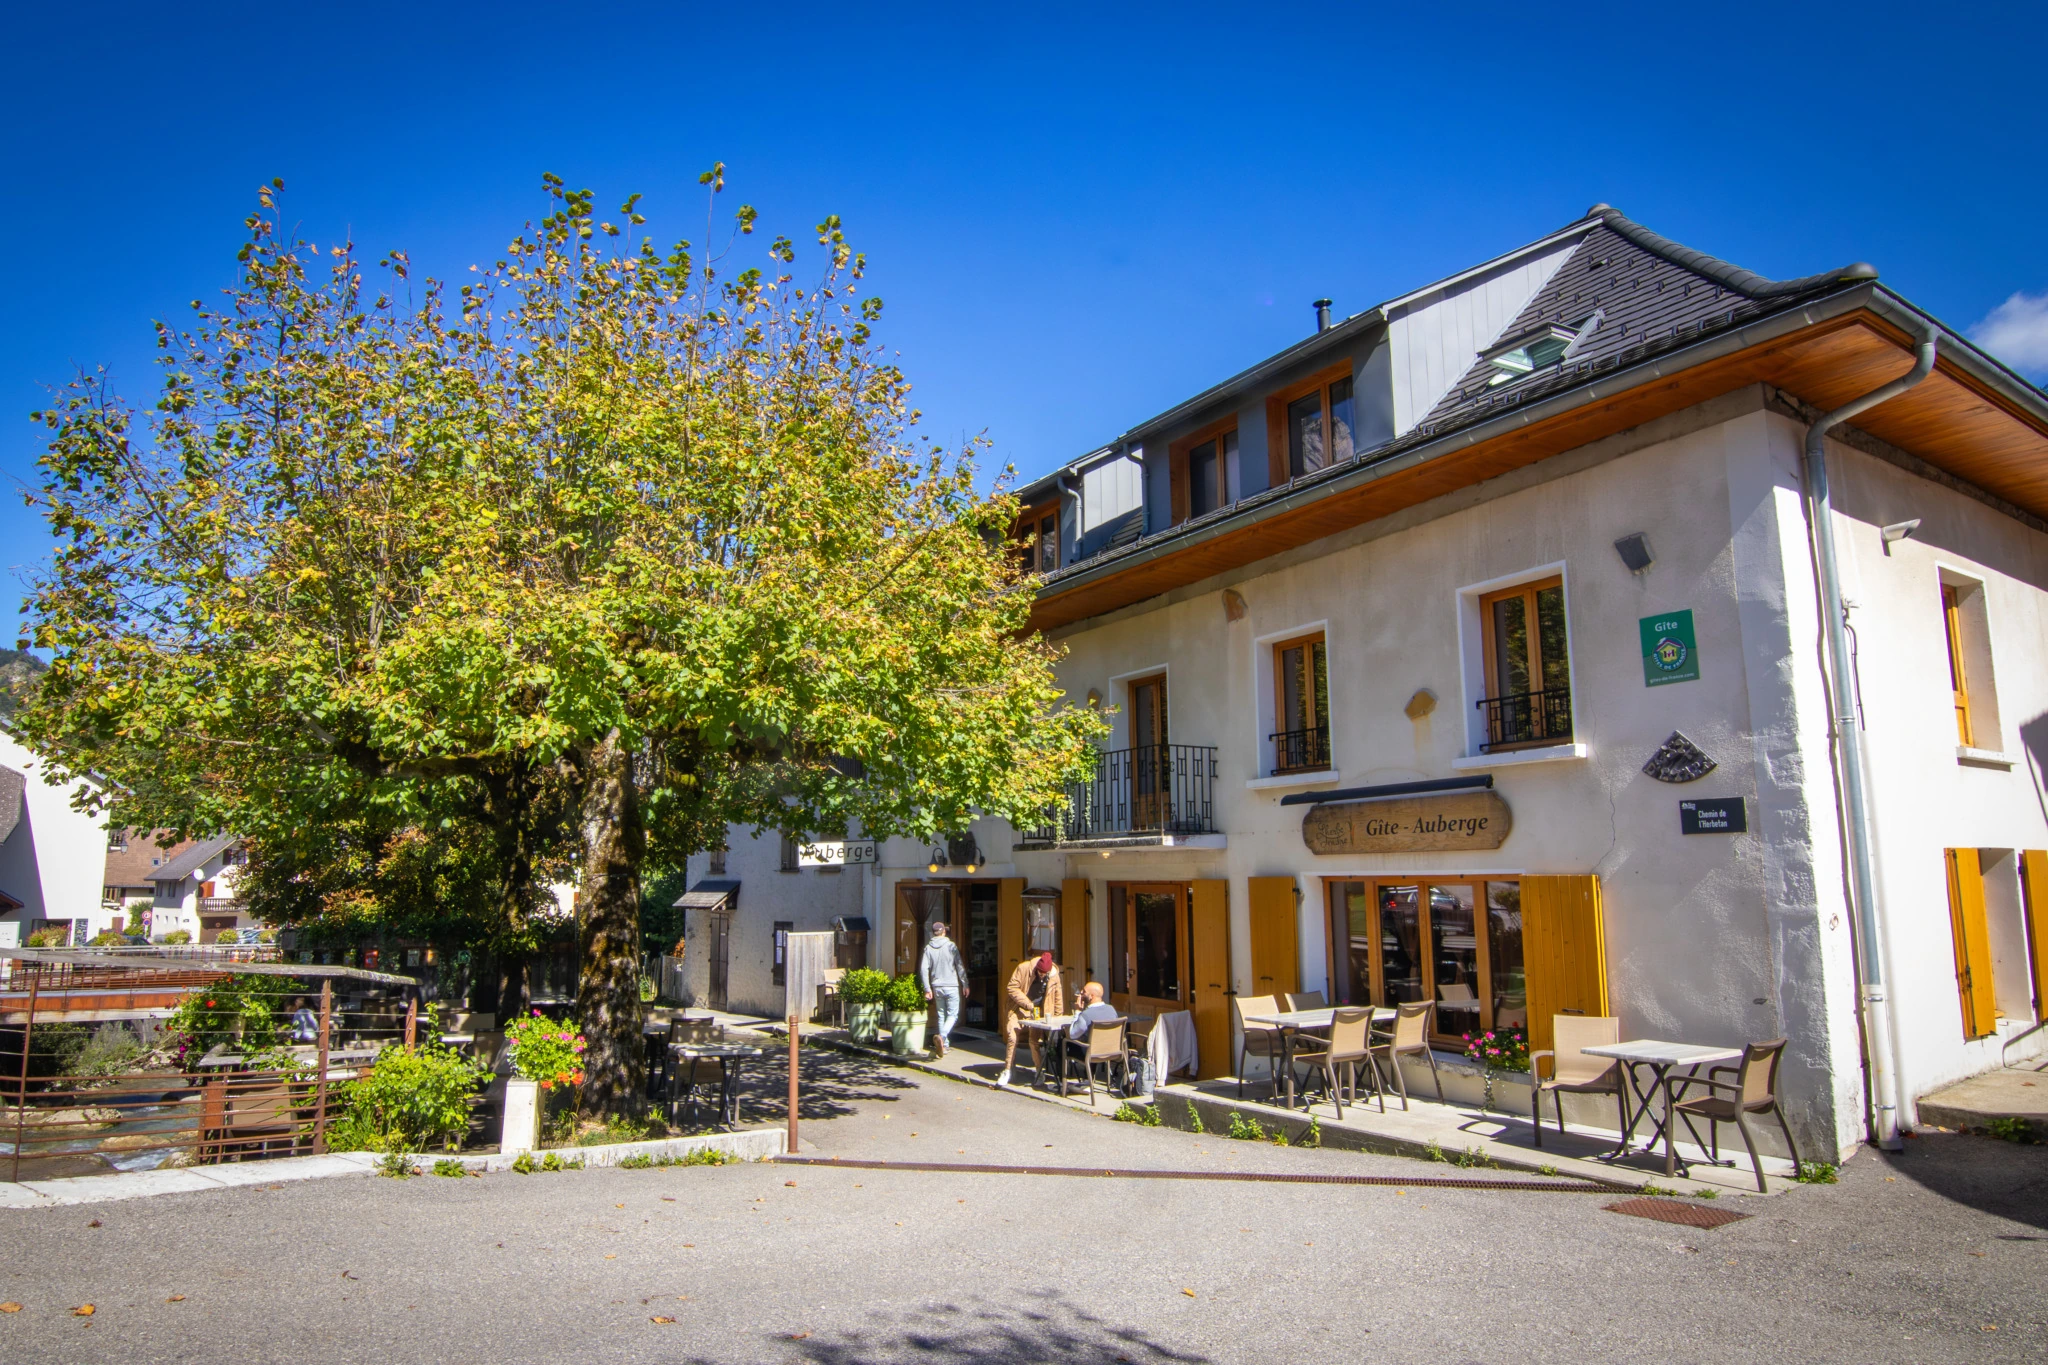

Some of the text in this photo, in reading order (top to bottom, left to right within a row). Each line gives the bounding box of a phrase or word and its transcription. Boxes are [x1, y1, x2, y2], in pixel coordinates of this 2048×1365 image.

[1698, 809, 1727, 819] Chemin de
[1366, 819, 1399, 836] Gîte
[1413, 814, 1489, 837] Auberge
